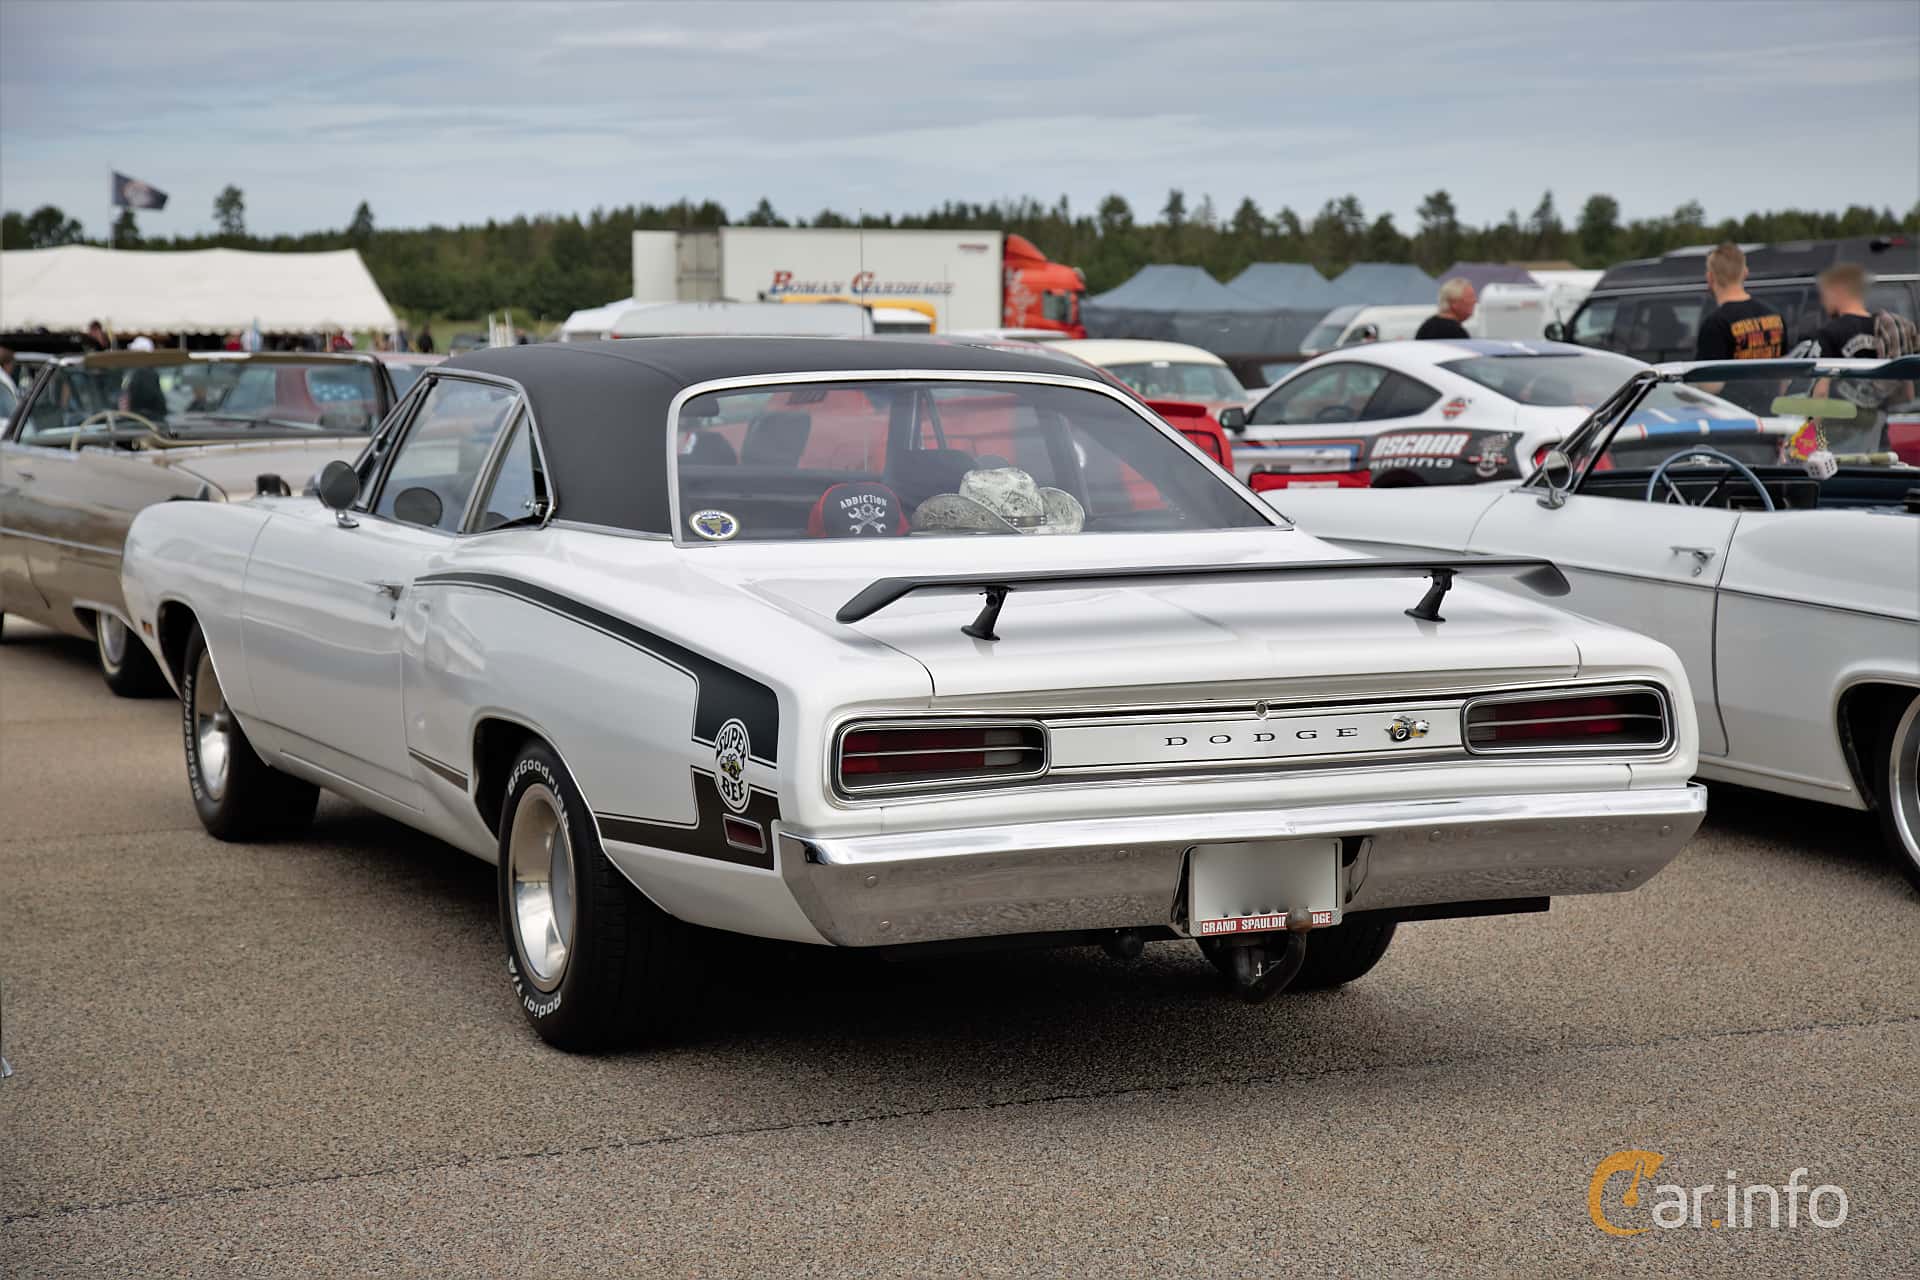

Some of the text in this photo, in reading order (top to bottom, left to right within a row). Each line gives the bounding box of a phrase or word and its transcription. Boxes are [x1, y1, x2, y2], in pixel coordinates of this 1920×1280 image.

[840, 495, 887, 509] ADDICTION
[1165, 727, 1358, 746] DODGE
[717, 727, 746, 770] SUPER
[721, 776, 744, 801] BEE
[1202, 912, 1331, 933] GRAND SPAULDIN DGE
[508, 955, 523, 997] T/A
